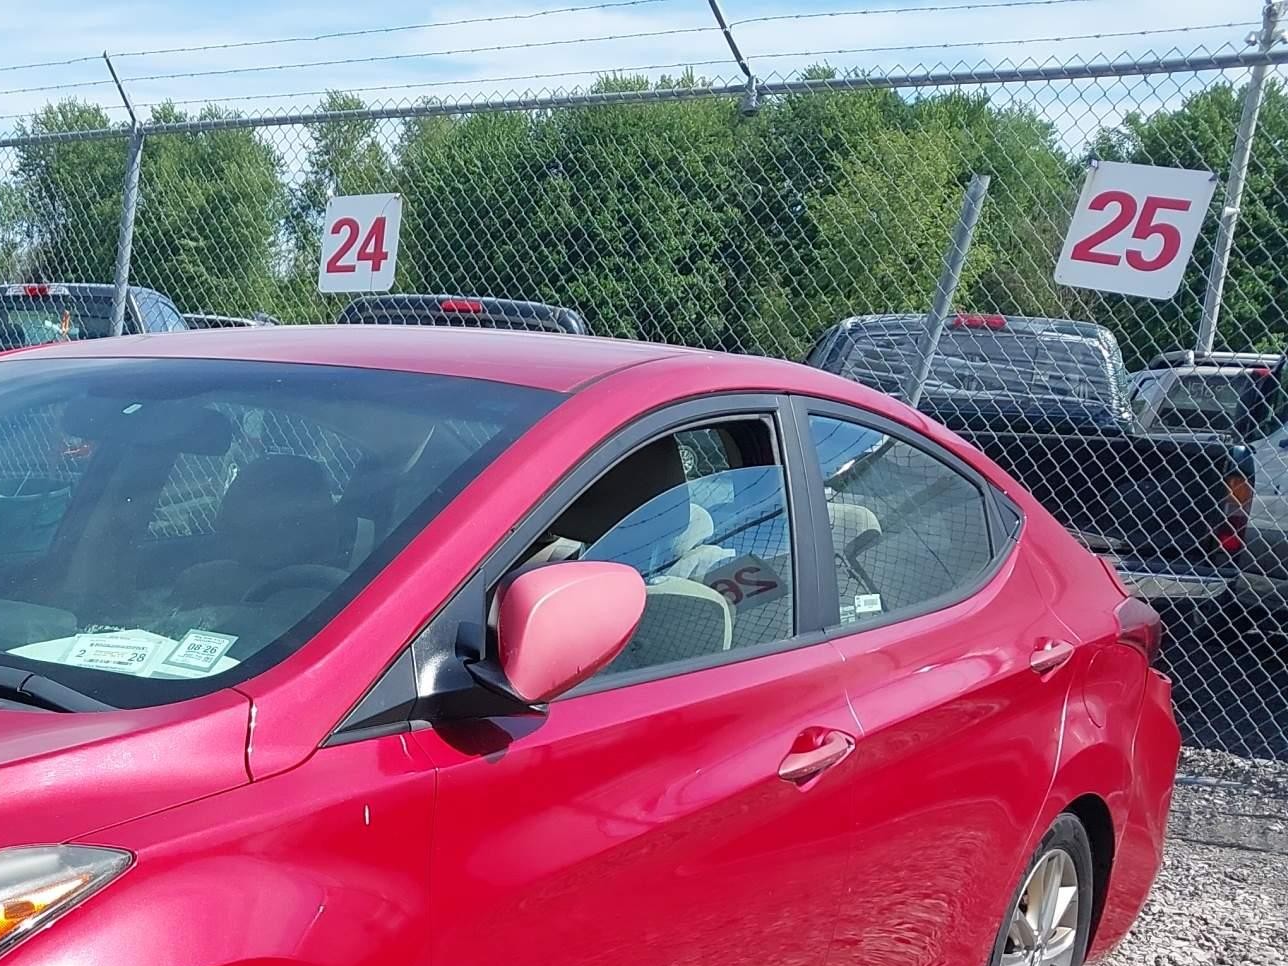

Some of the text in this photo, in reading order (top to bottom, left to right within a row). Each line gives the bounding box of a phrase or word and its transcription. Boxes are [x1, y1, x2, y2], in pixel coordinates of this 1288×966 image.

[326, 216, 389, 274] 24
[1070, 190, 1192, 273] 25
[128, 652, 147, 663] 28
